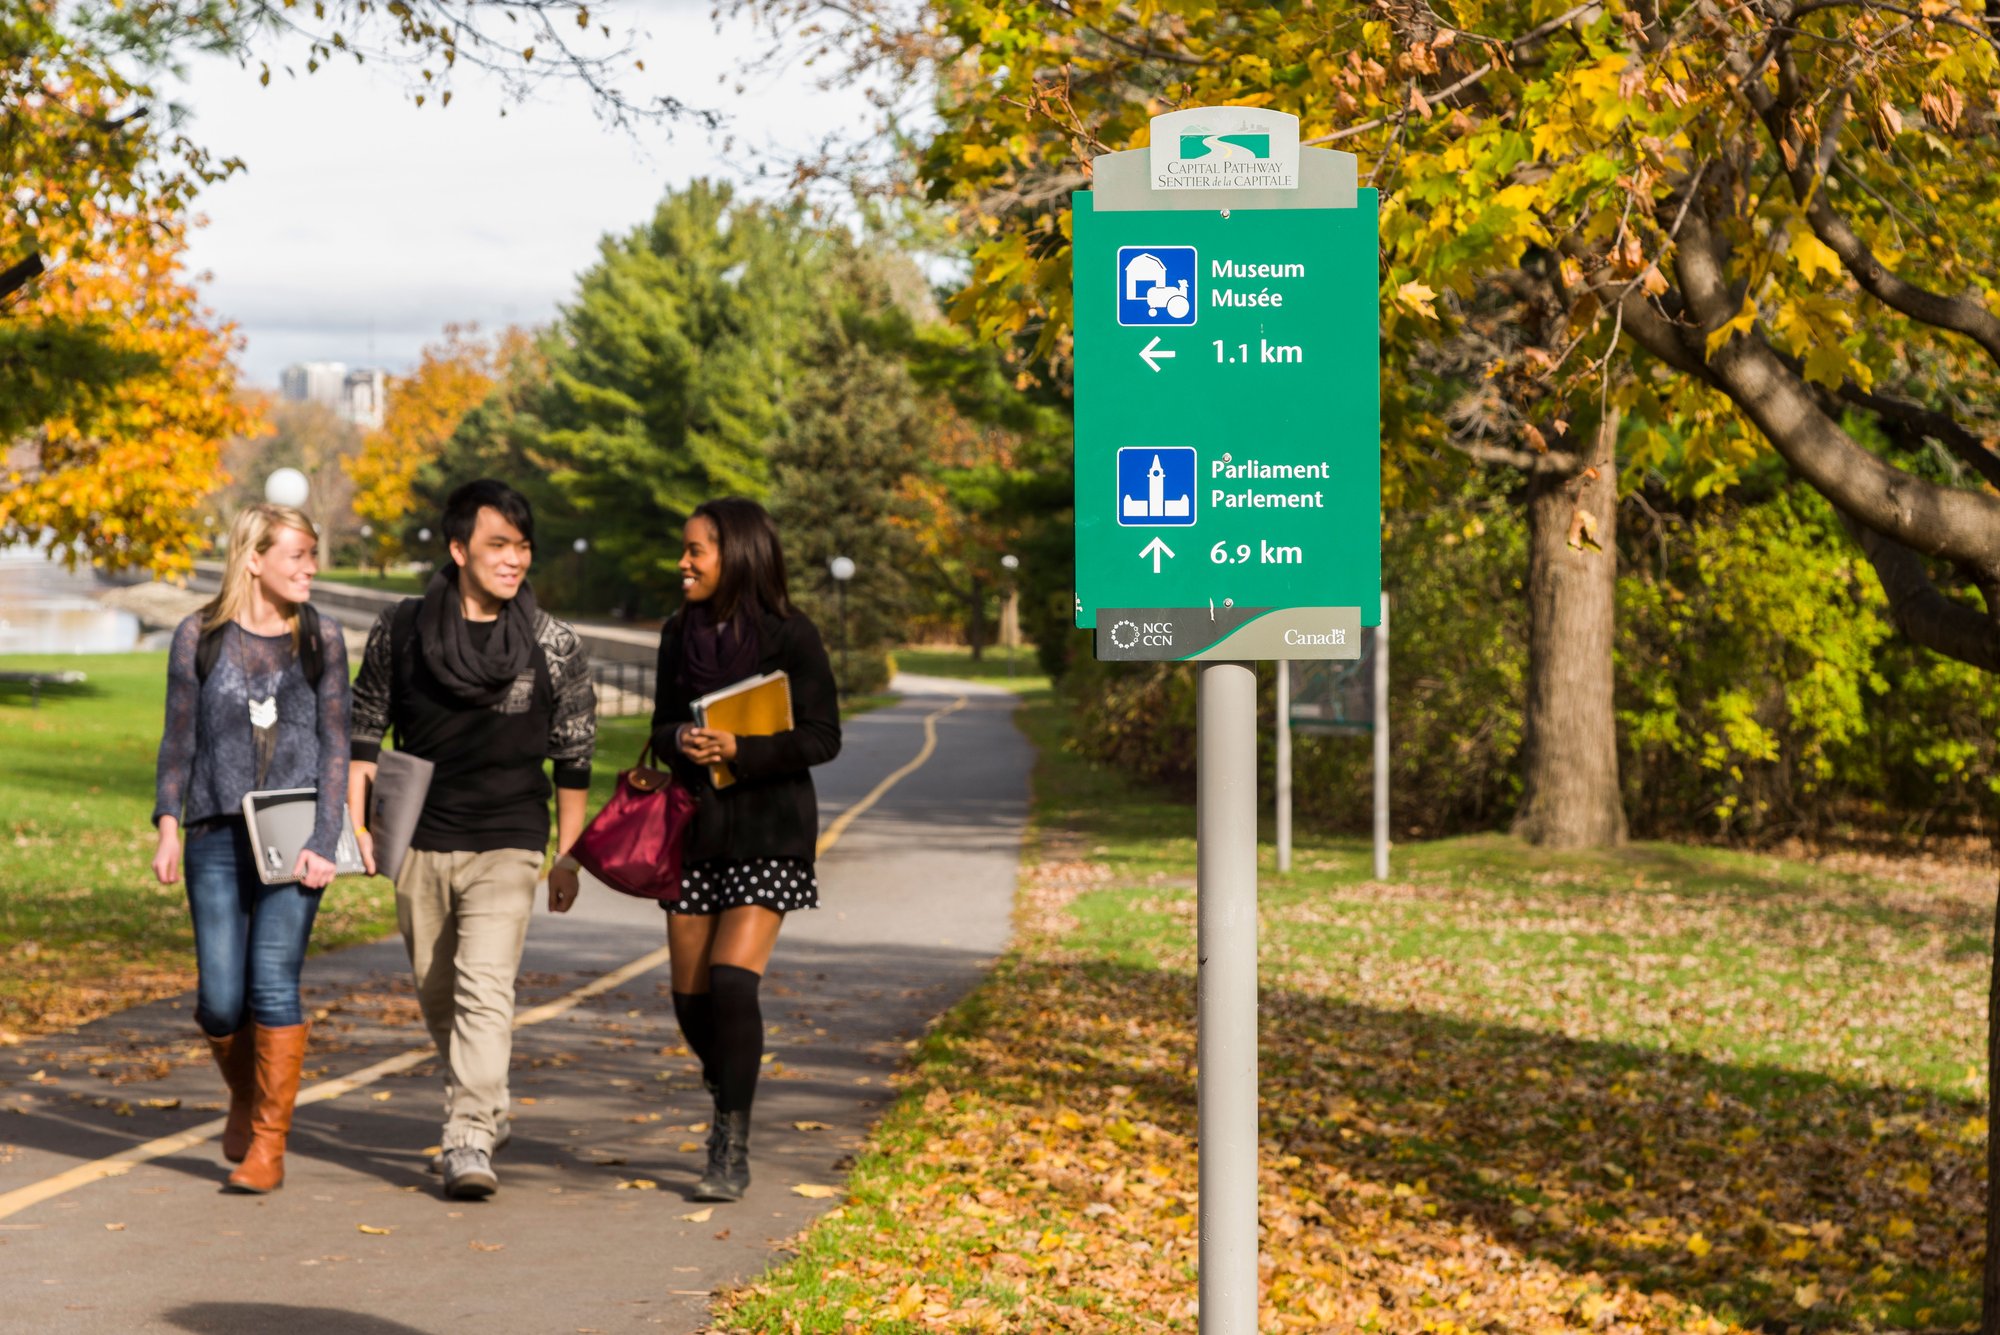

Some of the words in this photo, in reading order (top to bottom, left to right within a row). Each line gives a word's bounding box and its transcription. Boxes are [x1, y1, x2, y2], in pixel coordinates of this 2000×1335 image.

[1167, 161, 1220, 174] CAPITAL
[1223, 161, 1283, 174] PATHWAY
[1158, 175, 1210, 187] SENTIER
[1212, 177, 1222, 187] de
[1223, 177, 1232, 187] la
[1234, 175, 1292, 187] CAPITALE
[1212, 259, 1305, 278] Museum
[1212, 287, 1283, 307] Musée
[1212, 339, 1248, 363] 1.1
[1261, 339, 1303, 363] km
[1212, 459, 1330, 479] Parliament
[1212, 489, 1324, 508] Parlement
[1210, 540, 1251, 564] 6.9
[1261, 539, 1303, 564] km
[1143, 622, 1173, 634] NCC
[1284, 629, 1345, 645] Canada
[1143, 635, 1173, 646] CCN
